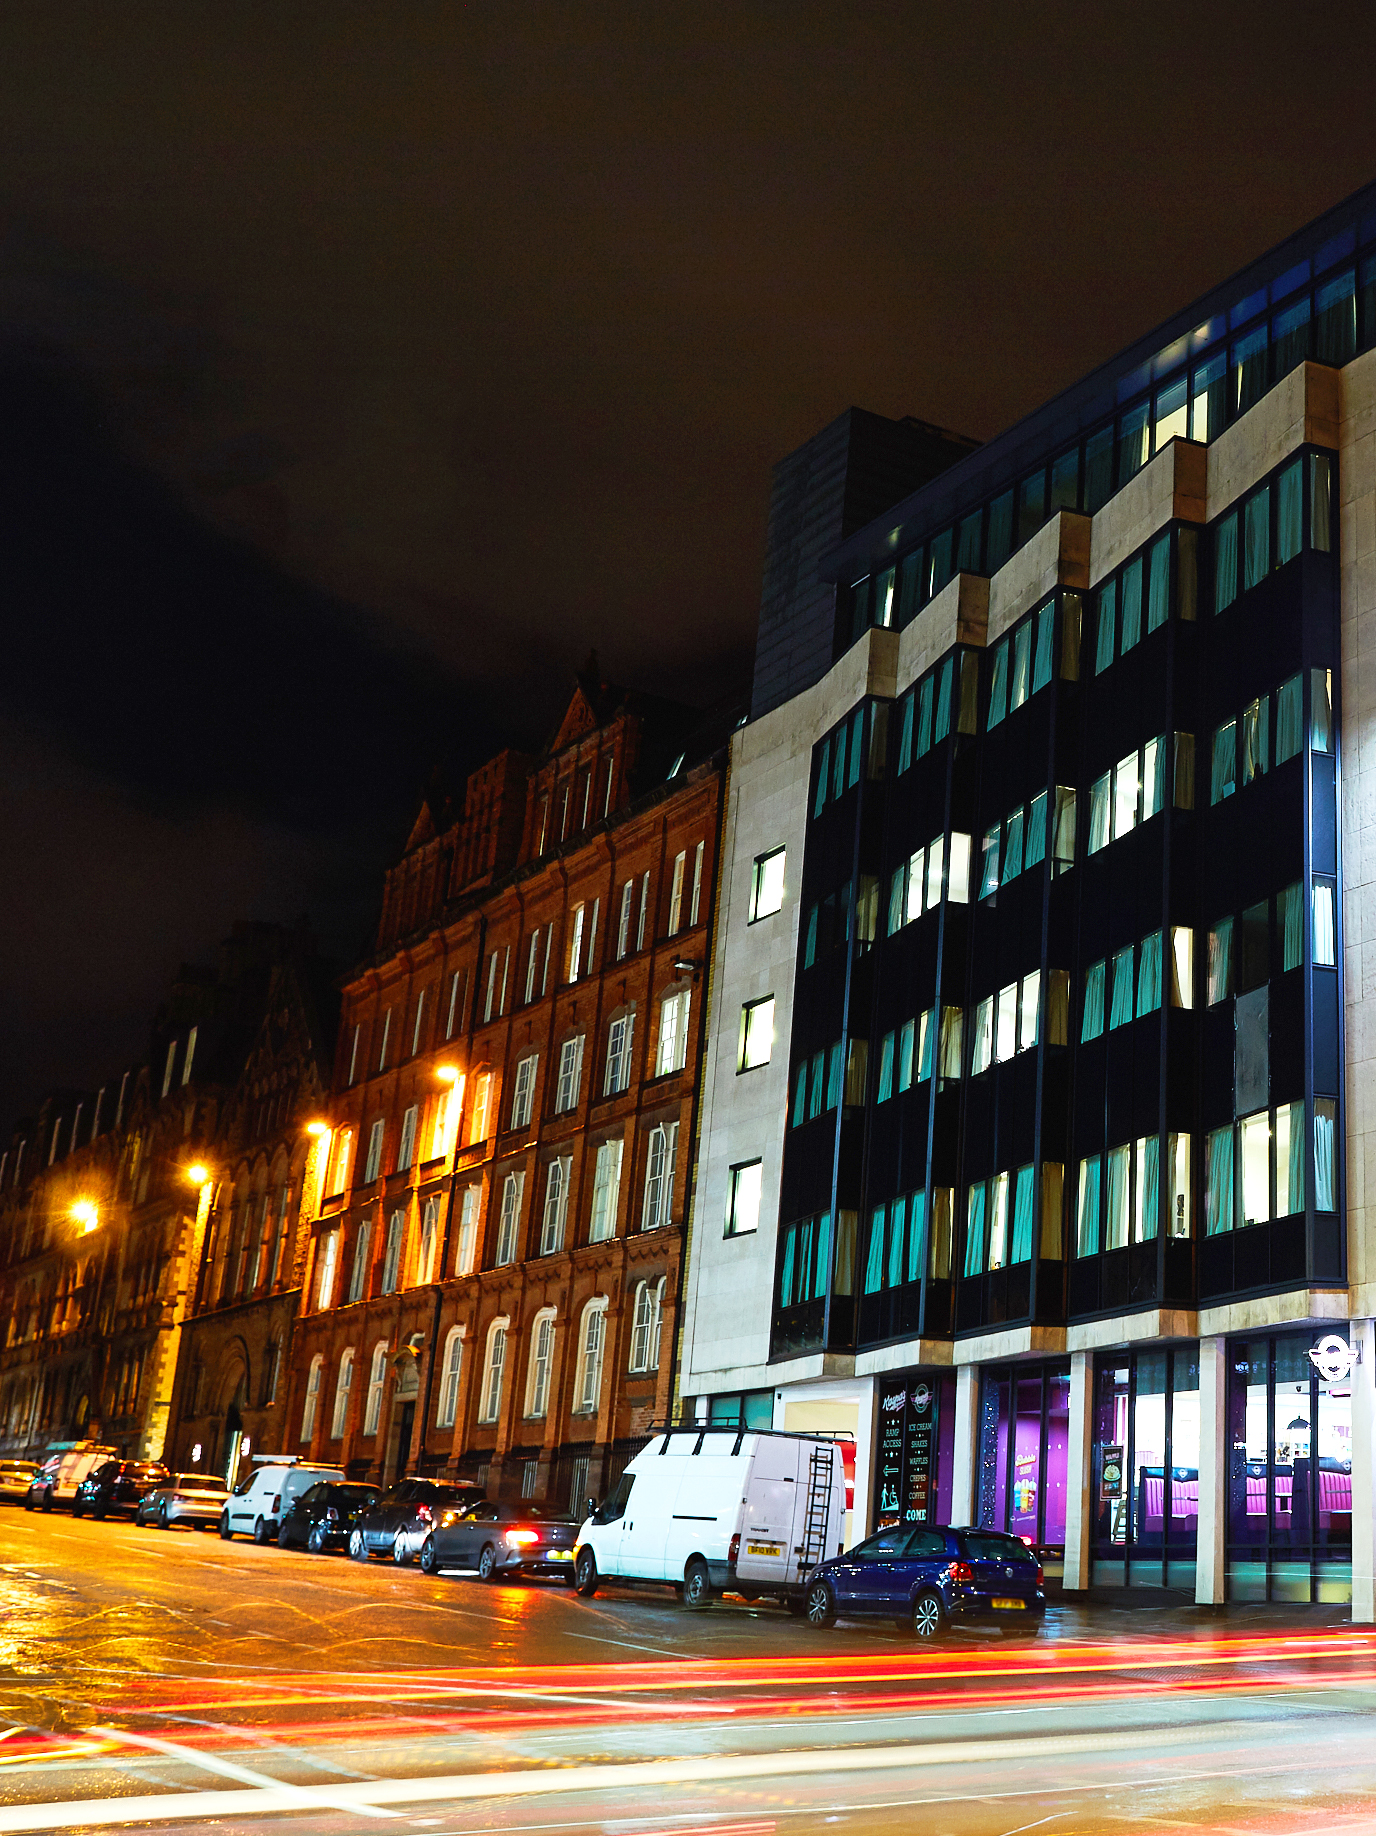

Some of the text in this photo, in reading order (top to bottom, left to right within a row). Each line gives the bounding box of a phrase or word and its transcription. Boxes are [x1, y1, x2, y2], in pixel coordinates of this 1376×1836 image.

[917, 1422, 932, 1431] CREAM
[885, 1428, 900, 1437] RAMP
[882, 1439, 902, 1448] ACCESS
[911, 1439, 928, 1448] SHAKES
[909, 1456, 929, 1465] WAFFLES
[909, 1474, 927, 1482] CREPES
[908, 1491, 926, 1500] COFFEE
[906, 1509, 927, 1521] COME
